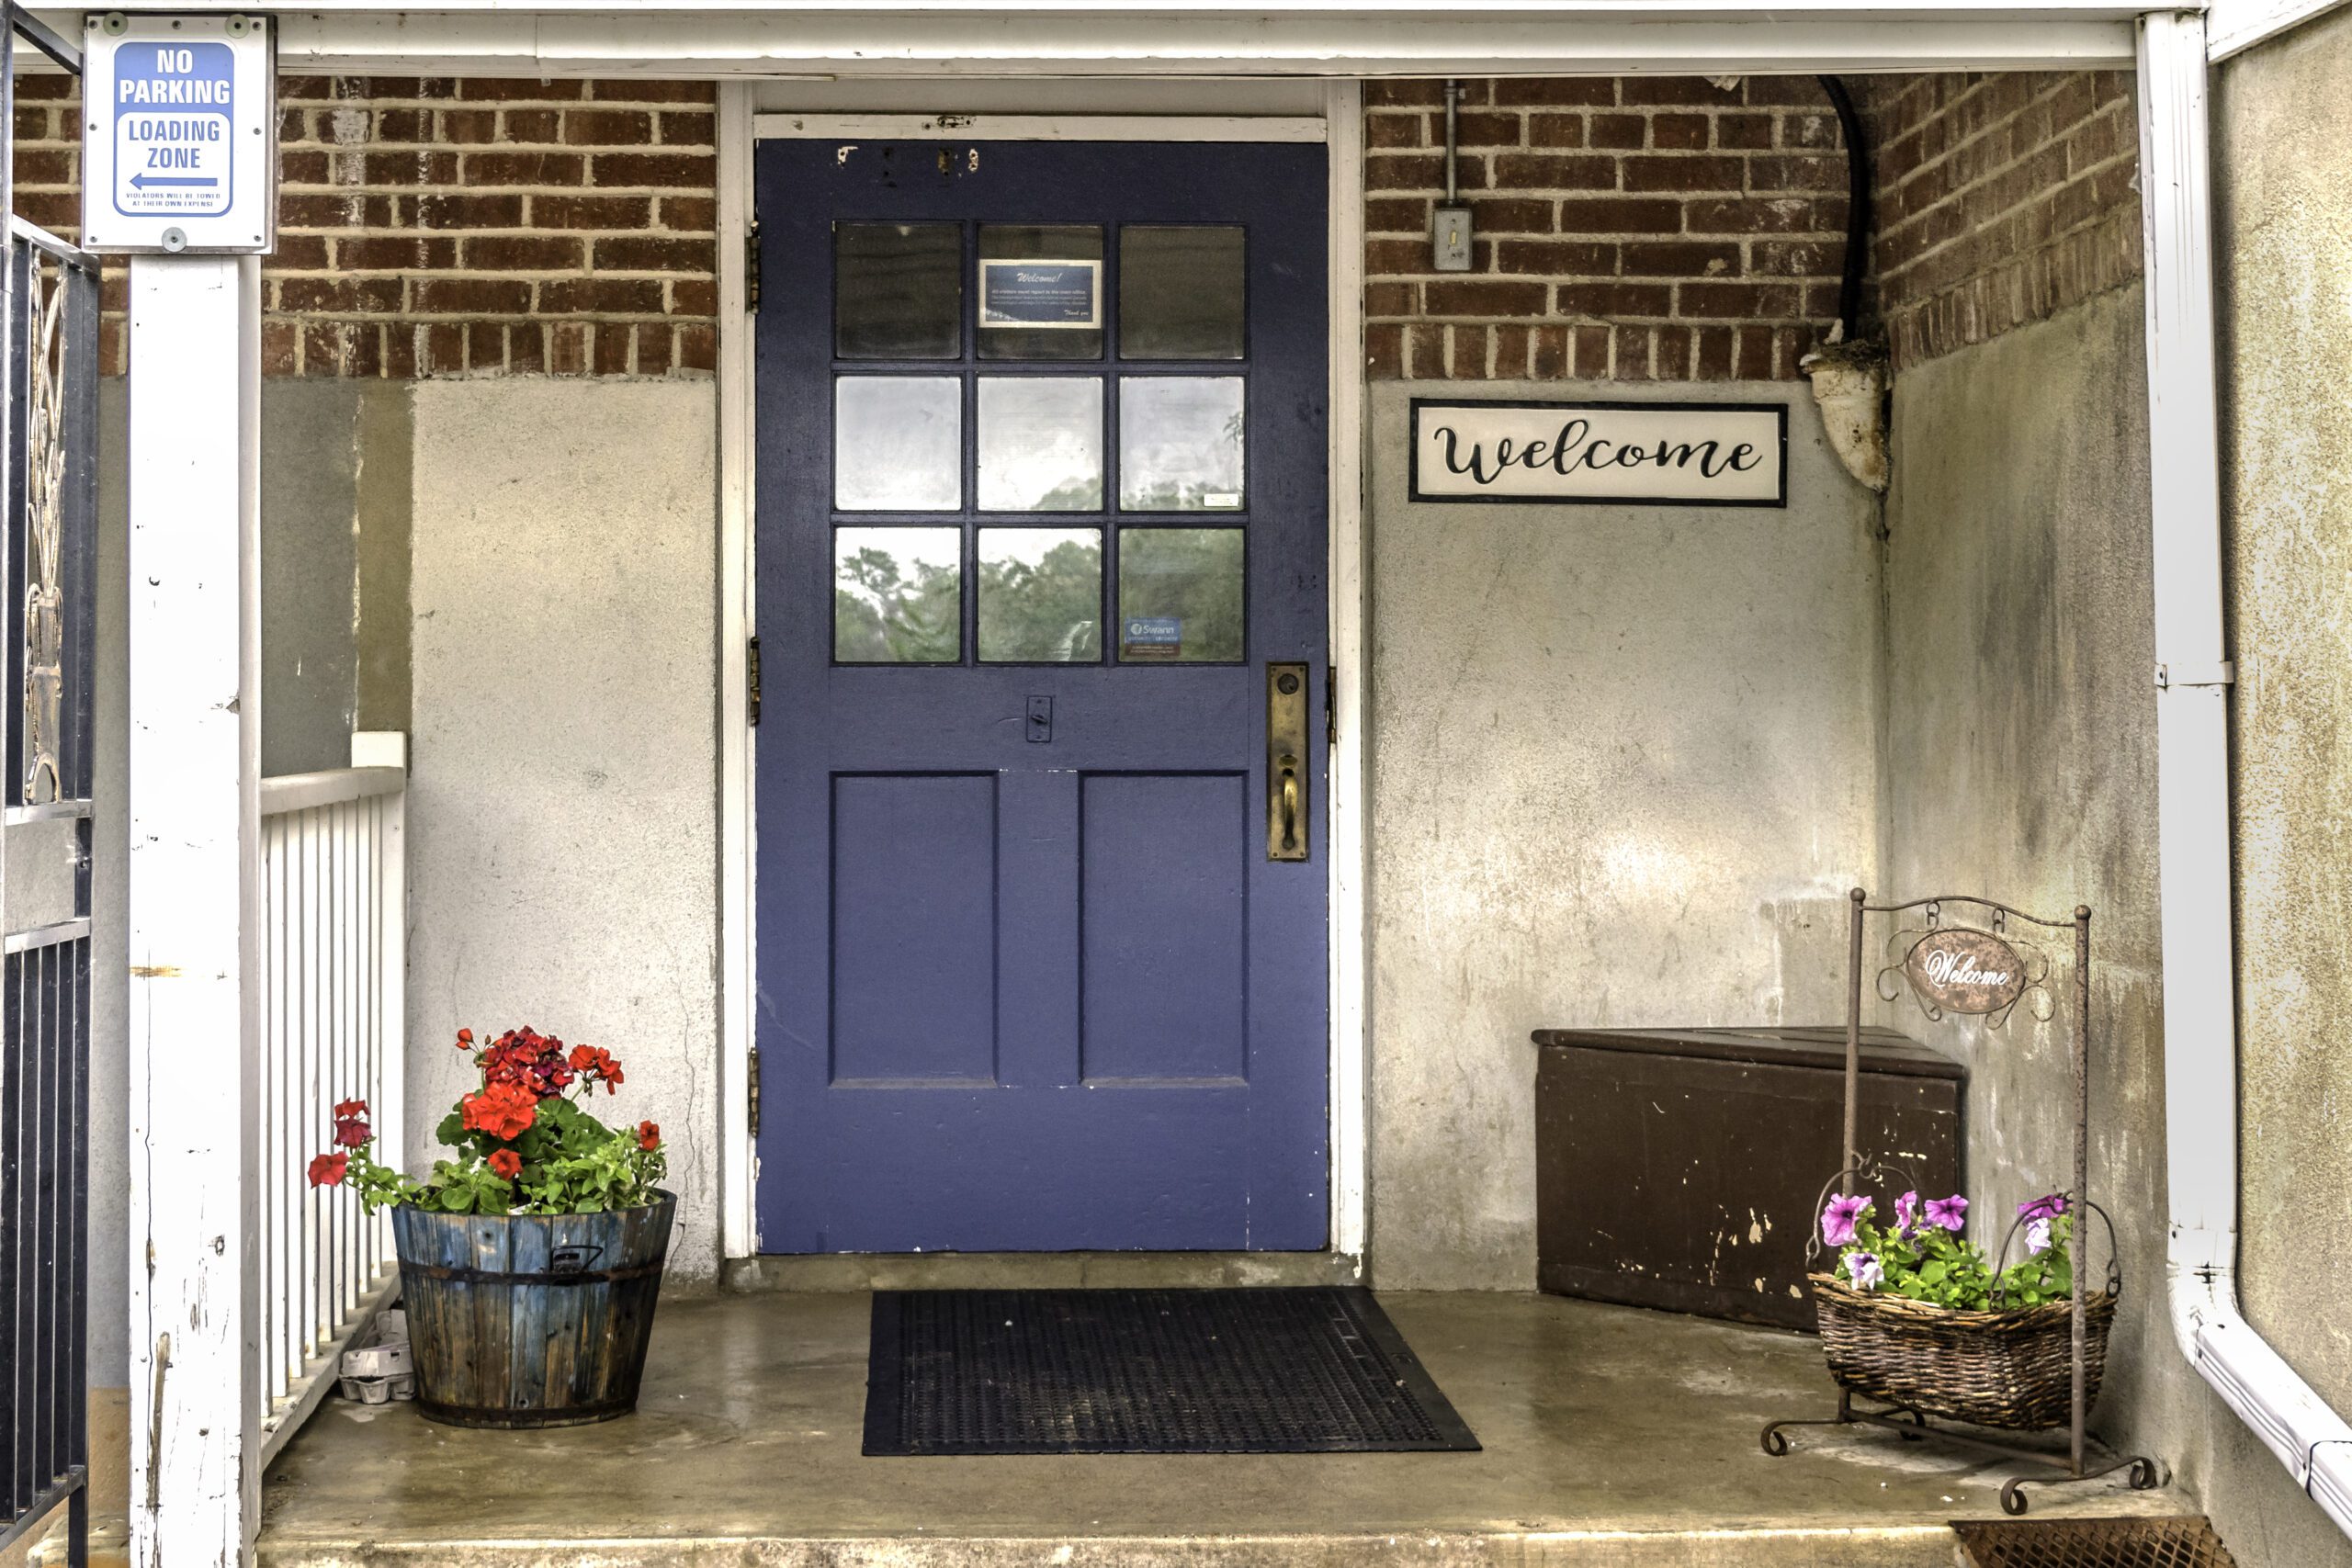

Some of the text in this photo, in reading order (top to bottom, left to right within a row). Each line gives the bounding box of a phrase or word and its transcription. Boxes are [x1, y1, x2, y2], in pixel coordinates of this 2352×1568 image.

[156, 50, 193, 73] NO
[119, 80, 230, 104] PARKING
[129, 120, 220, 141] LOADING
[147, 148, 200, 168] ZONE
[1016, 272, 1063, 283] Welcome!
[1143, 625, 1174, 634] Swann
[1926, 950, 2009, 987] Welcome
